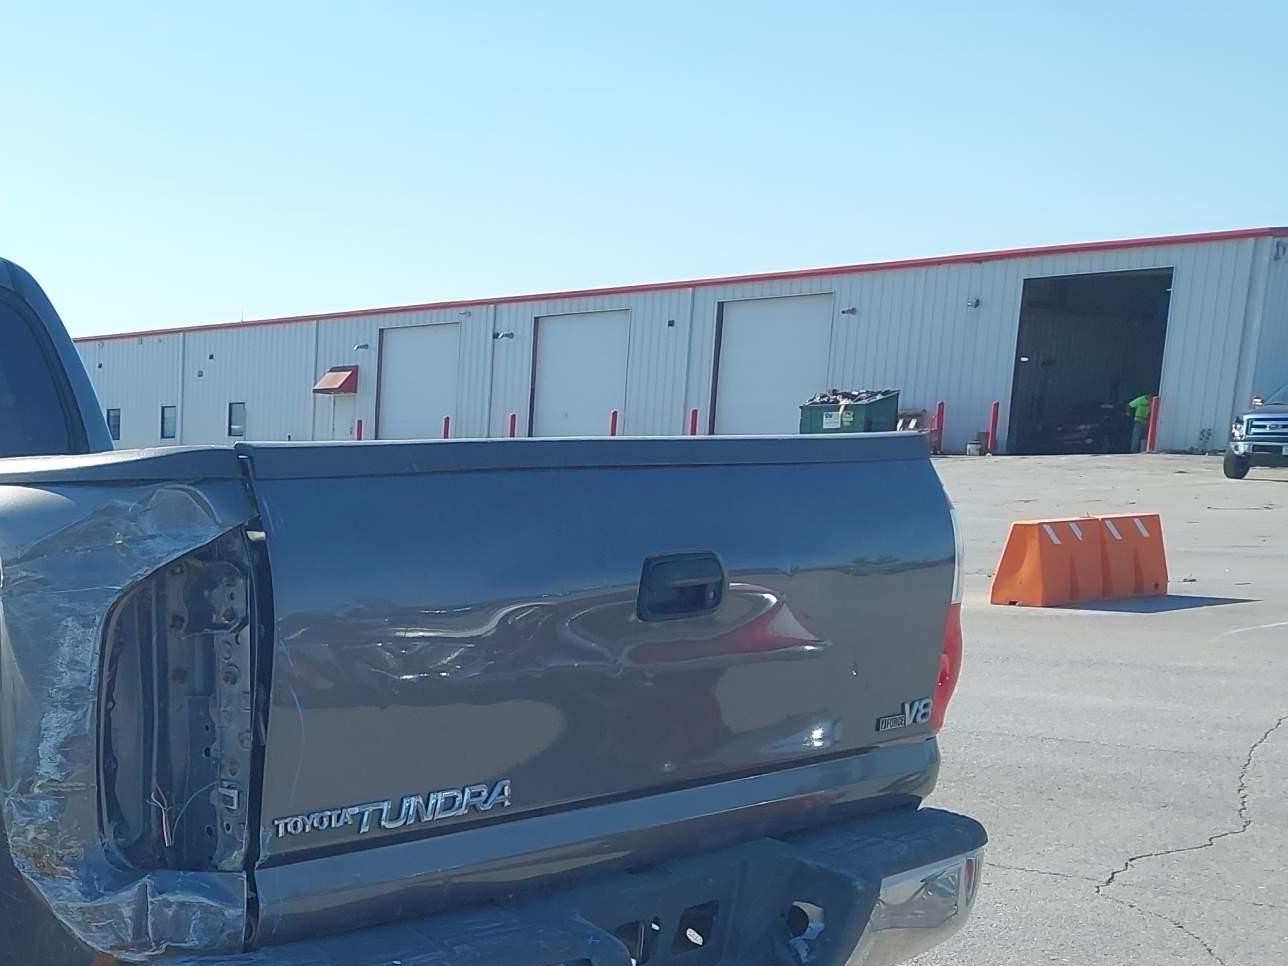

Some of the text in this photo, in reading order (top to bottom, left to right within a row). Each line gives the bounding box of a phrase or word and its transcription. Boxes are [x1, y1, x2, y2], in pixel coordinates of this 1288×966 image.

[904, 698, 933, 726] V8
[274, 779, 512, 838] TOYOTA TUNDRA
